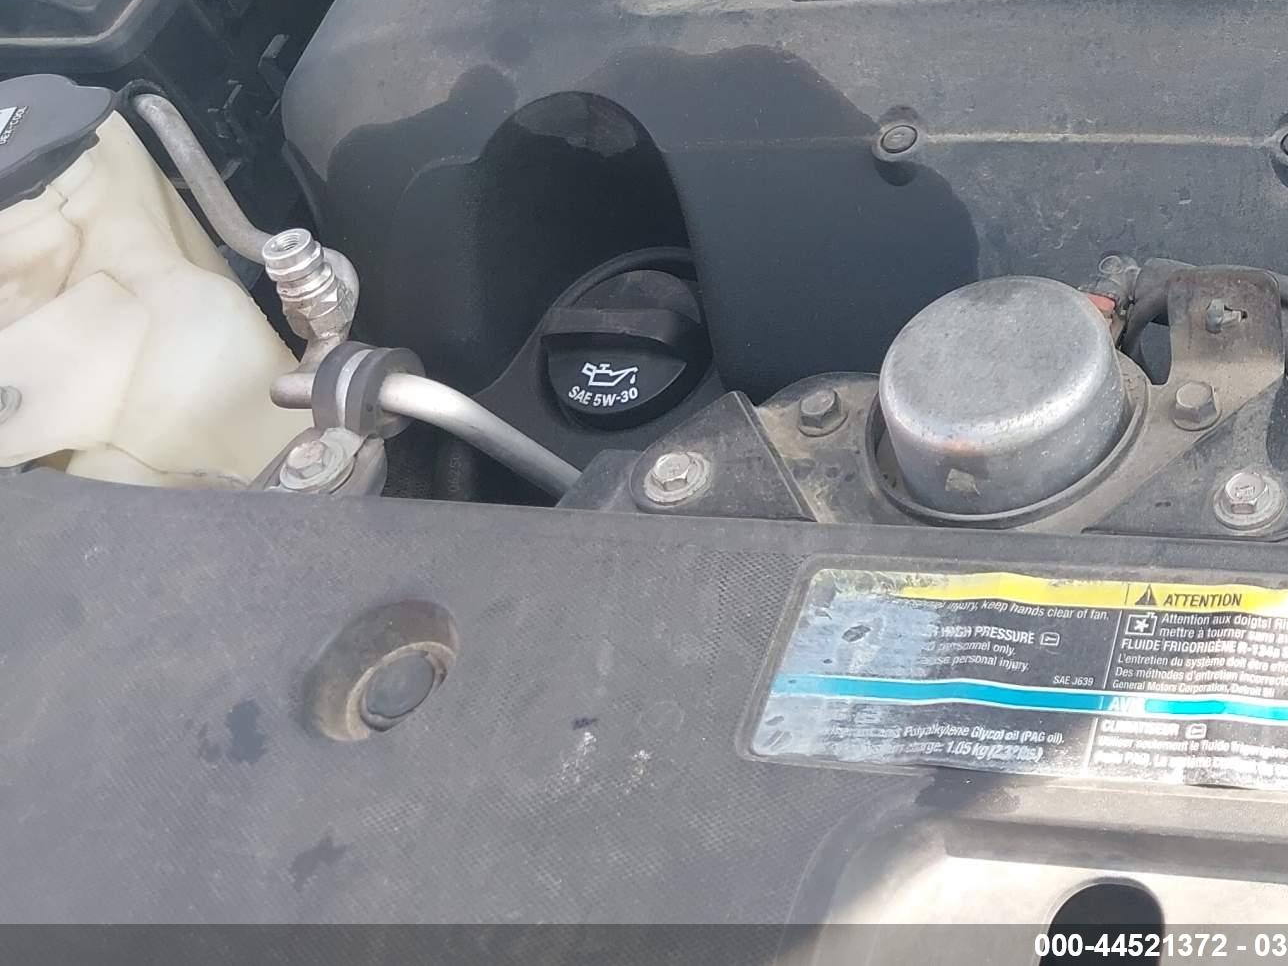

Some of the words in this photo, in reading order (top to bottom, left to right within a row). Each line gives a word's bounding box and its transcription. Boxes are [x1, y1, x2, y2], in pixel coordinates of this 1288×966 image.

[568, 386, 592, 405] SAE
[593, 387, 638, 407] 5W-30
[1163, 593, 1243, 608] ATTENTION
[981, 599, 1007, 612] keep
[1010, 602, 1044, 617] hands
[1047, 607, 1074, 619] clear
[1076, 608, 1088, 619] of
[1090, 609, 1110, 620] fan.
[1161, 613, 1210, 626] Attention
[1212, 616, 1231, 625] aux
[974, 626, 1035, 645] PRESSURE
[1159, 626, 1195, 639] mettre
[1198, 626, 1206, 639] à
[1207, 628, 1247, 641] tourner
[993, 643, 1017, 657] only.
[1121, 638, 1161, 651] FLUIDE
[951, 653, 997, 668] personal
[999, 656, 1030, 673] injury.
[1117, 652, 1170, 666] L'entretien
[1170, 655, 1183, 667] du
[1185, 655, 1226, 670] système
[1052, 675, 1071, 686] SAE
[1072, 676, 1094, 687] J639
[1115, 666, 1134, 678] Des
[1136, 666, 1184, 681] méthodes
[1112, 679, 1146, 690] General
[1021, 730, 1044, 743] (PAG
[1046, 731, 1065, 744] oil).
[971, 743, 989, 760] kg
